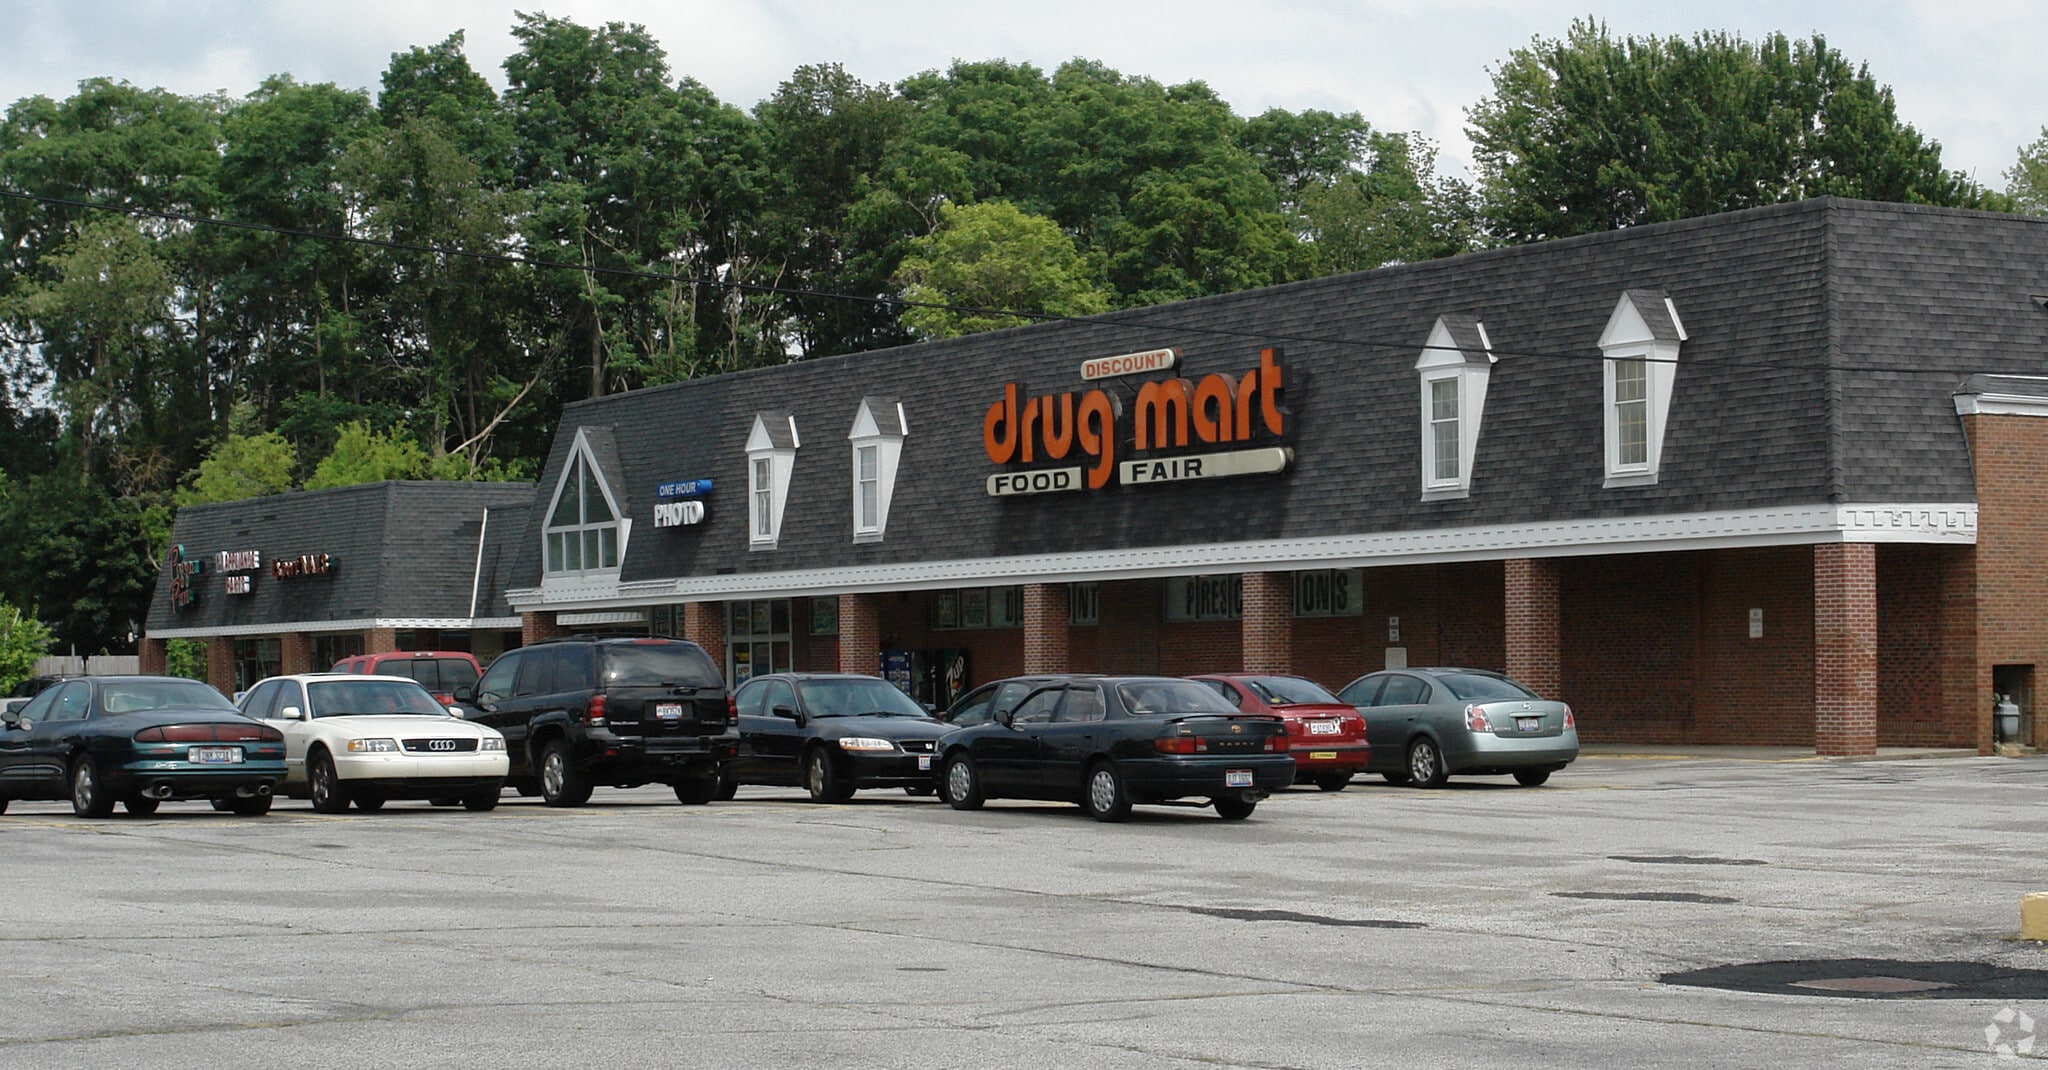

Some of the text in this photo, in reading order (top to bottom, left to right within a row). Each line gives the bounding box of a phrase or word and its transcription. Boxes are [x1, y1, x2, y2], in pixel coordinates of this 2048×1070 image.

[1085, 352, 1166, 378] DISCOUNT
[983, 347, 1284, 490] drug mart
[659, 481, 697, 497] ONE HOUR
[994, 458, 1203, 494] FOOD FAIR
[654, 501, 702, 528] PHOTO
